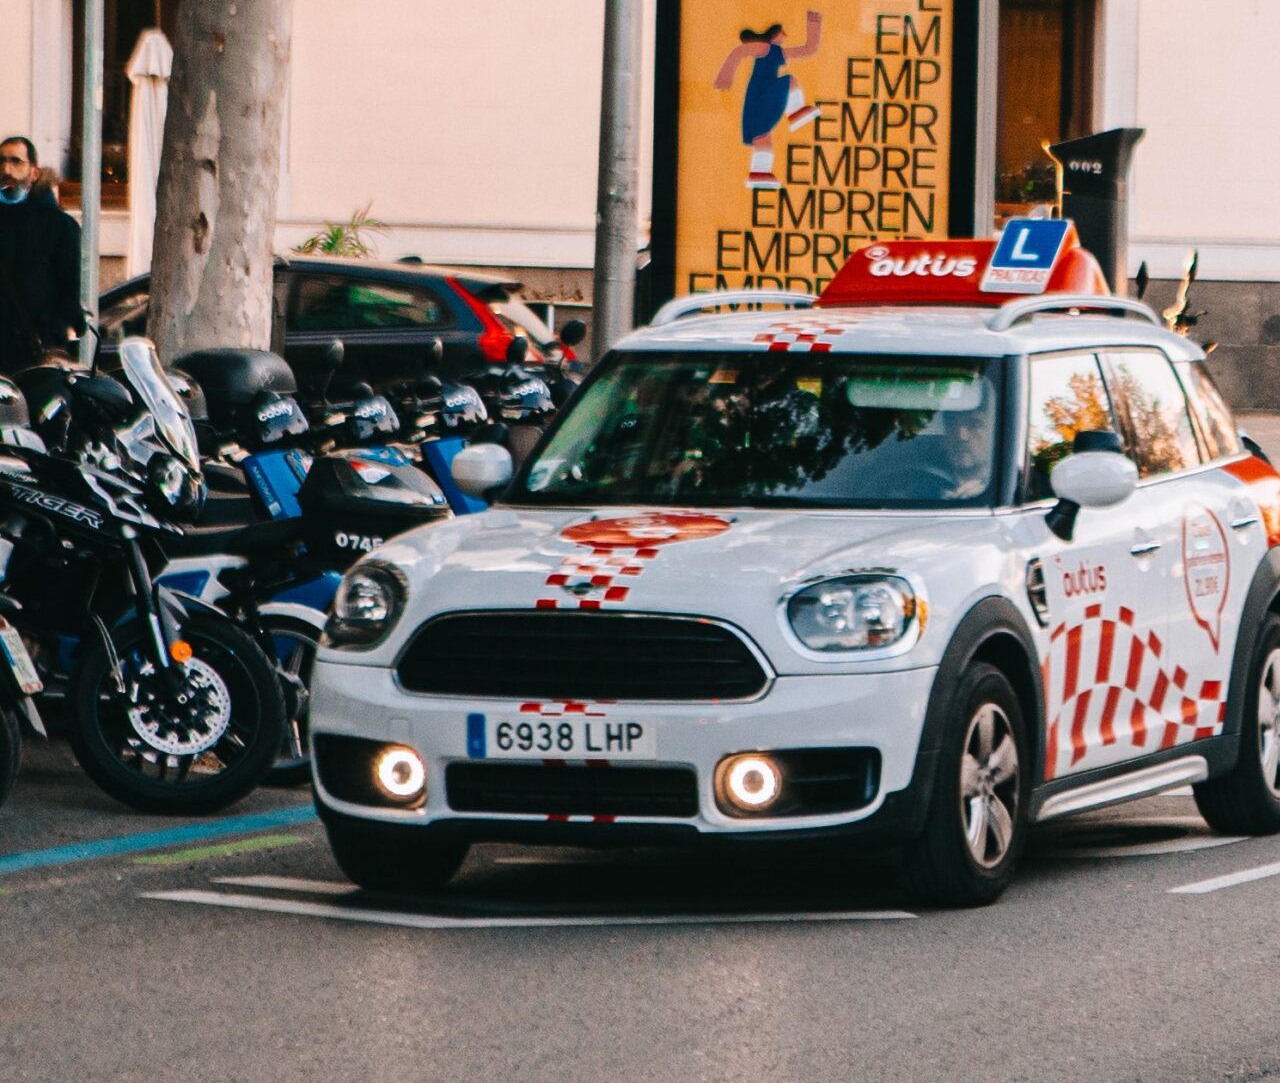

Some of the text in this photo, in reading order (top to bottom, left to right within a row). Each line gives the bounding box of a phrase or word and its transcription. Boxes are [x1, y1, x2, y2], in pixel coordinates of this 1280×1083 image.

[876, 14, 941, 56] EM
[847, 57, 941, 99] EMP
[814, 101, 938, 145] EMPR
[786, 144, 937, 189] EMPRE
[752, 188, 935, 233] EMPREN
[1011, 228, 1039, 260] L
[258, 400, 293, 422] cabify
[11, 486, 104, 529] TIGER
[496, 722, 643, 753] 6938 LHP
